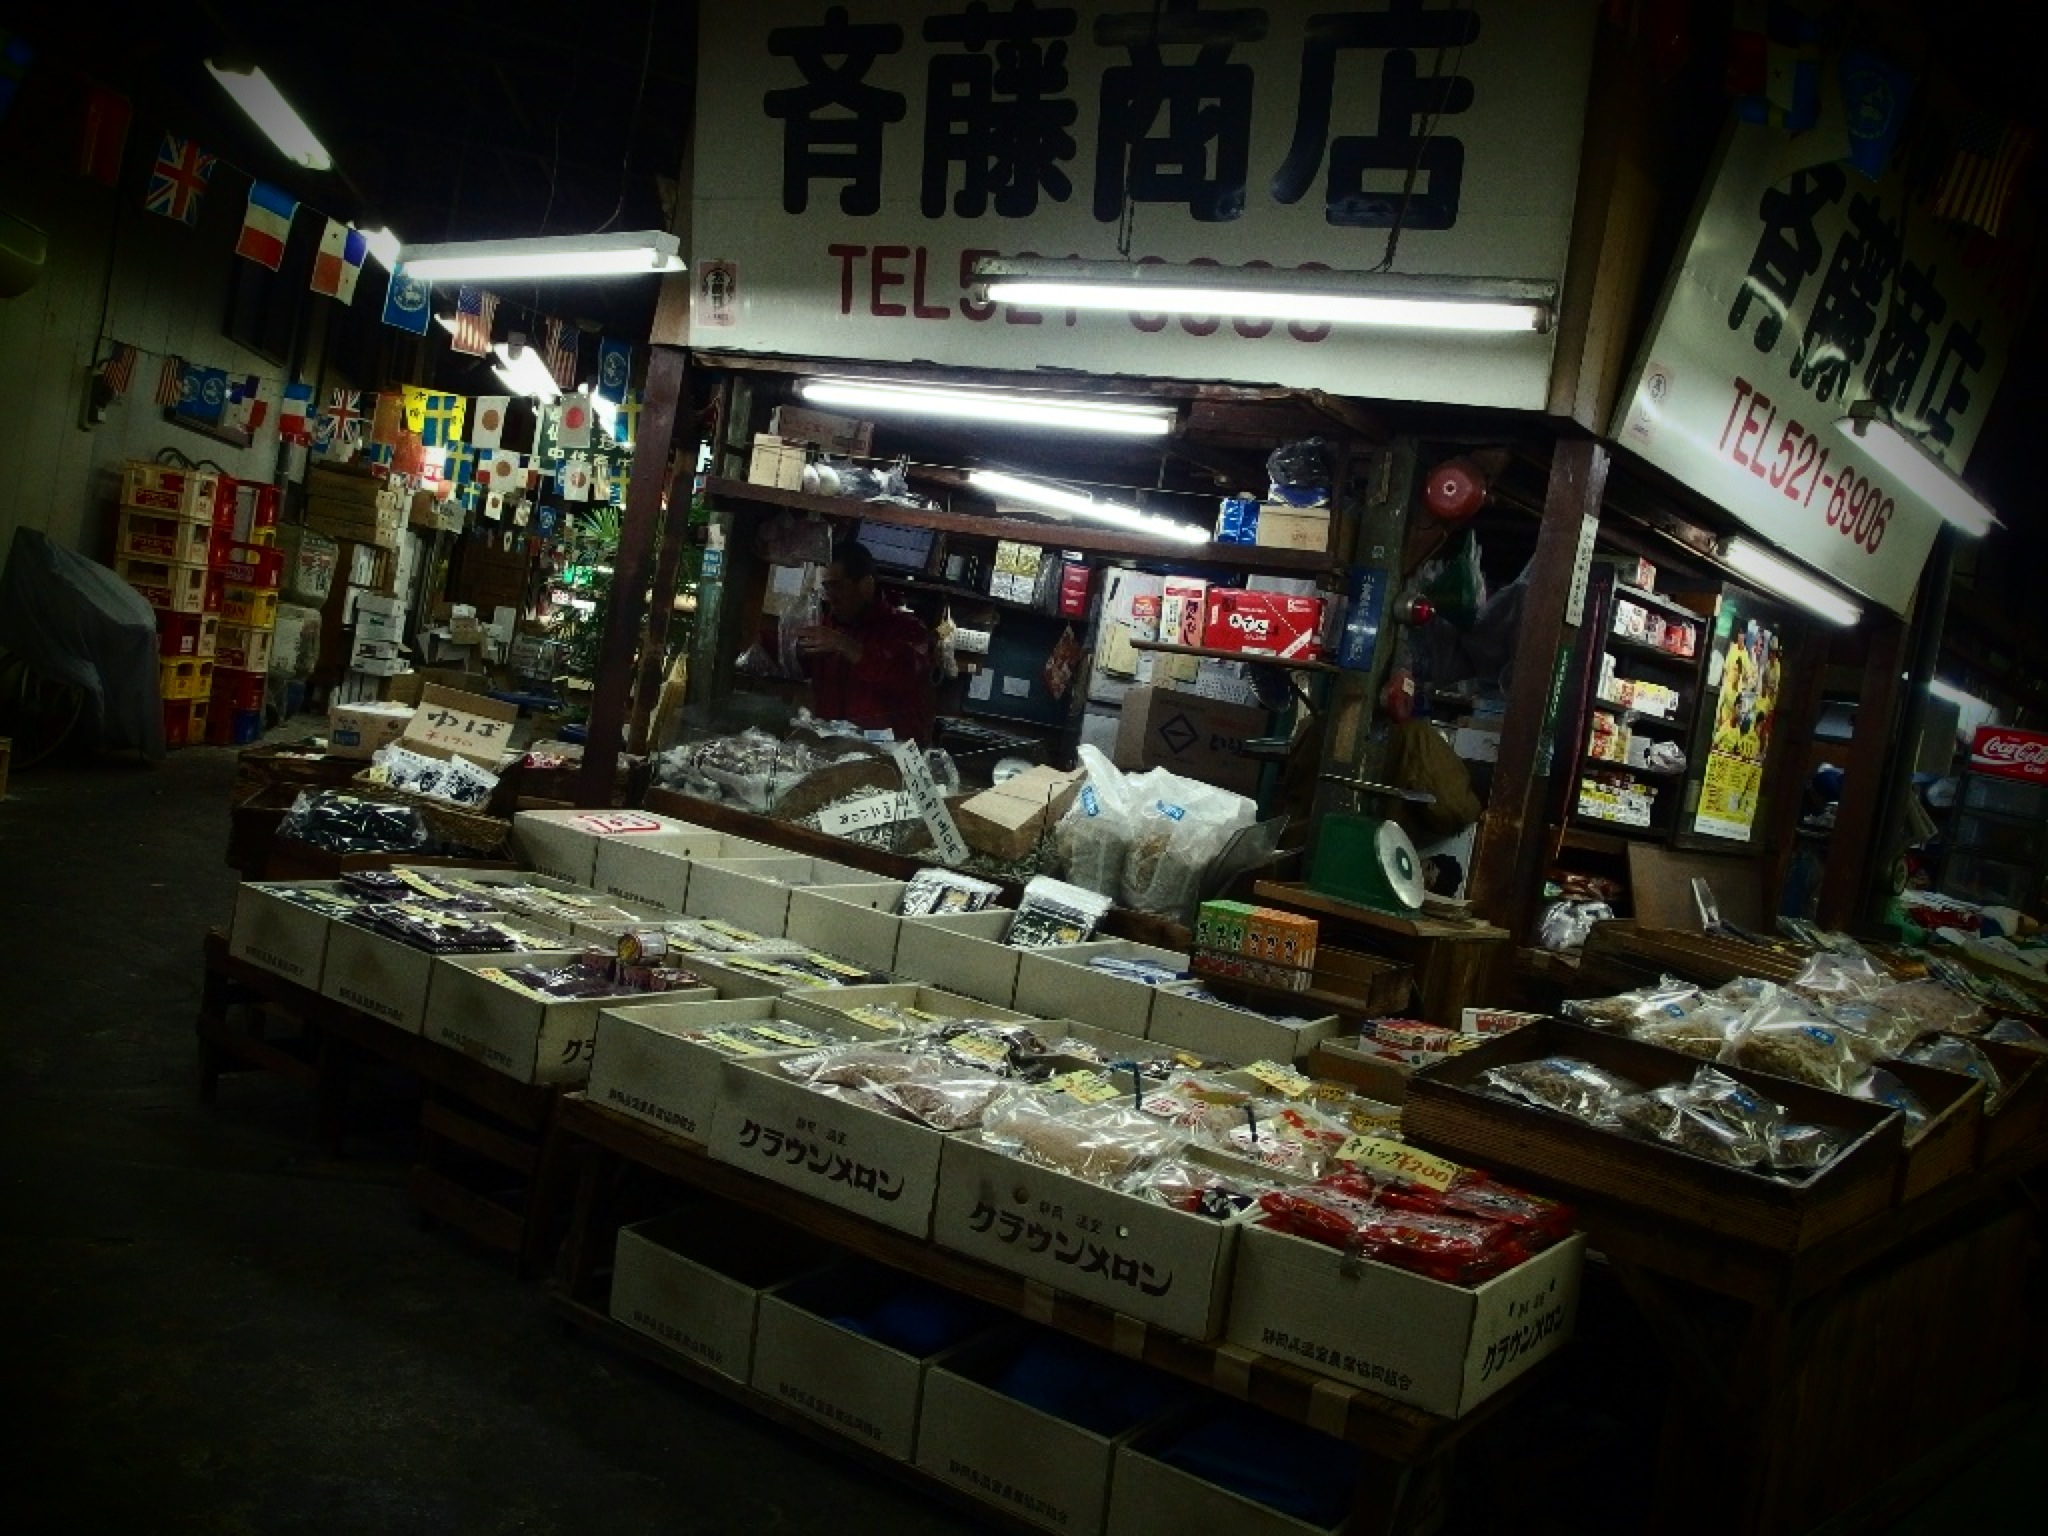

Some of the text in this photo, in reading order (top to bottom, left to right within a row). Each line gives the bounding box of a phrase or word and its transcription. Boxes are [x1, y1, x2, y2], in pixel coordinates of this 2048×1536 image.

[763, 0, 1482, 231] 斉藤商店
[427, 710, 505, 737] ゆば
[738, 1117, 905, 1202] クラウンメロン
[968, 1199, 1174, 1298] クラウンメロン
[1481, 1305, 1566, 1382] クラウンメロン
